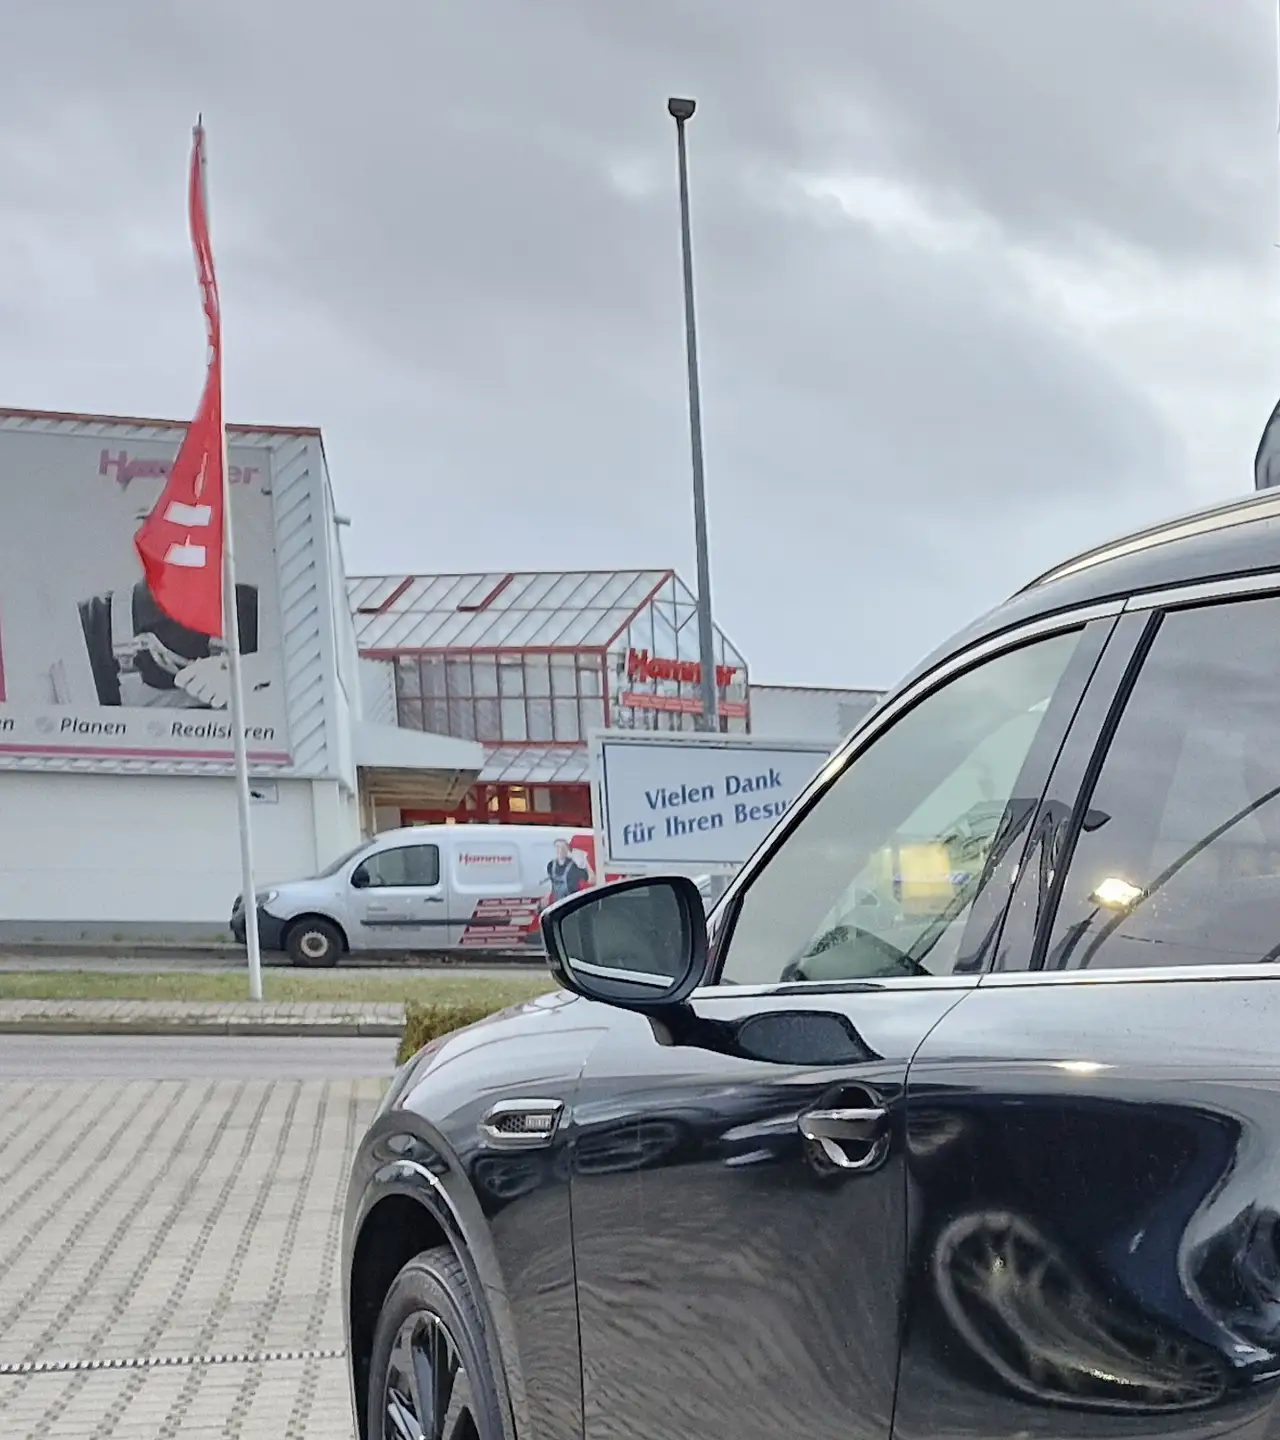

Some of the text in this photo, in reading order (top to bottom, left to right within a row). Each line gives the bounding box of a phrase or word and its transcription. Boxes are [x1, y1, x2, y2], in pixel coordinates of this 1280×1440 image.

[60, 716, 275, 741] Planen Realisiren
[645, 767, 782, 810] Vielen Dank
[623, 798, 795, 846] für Ihren Besu
